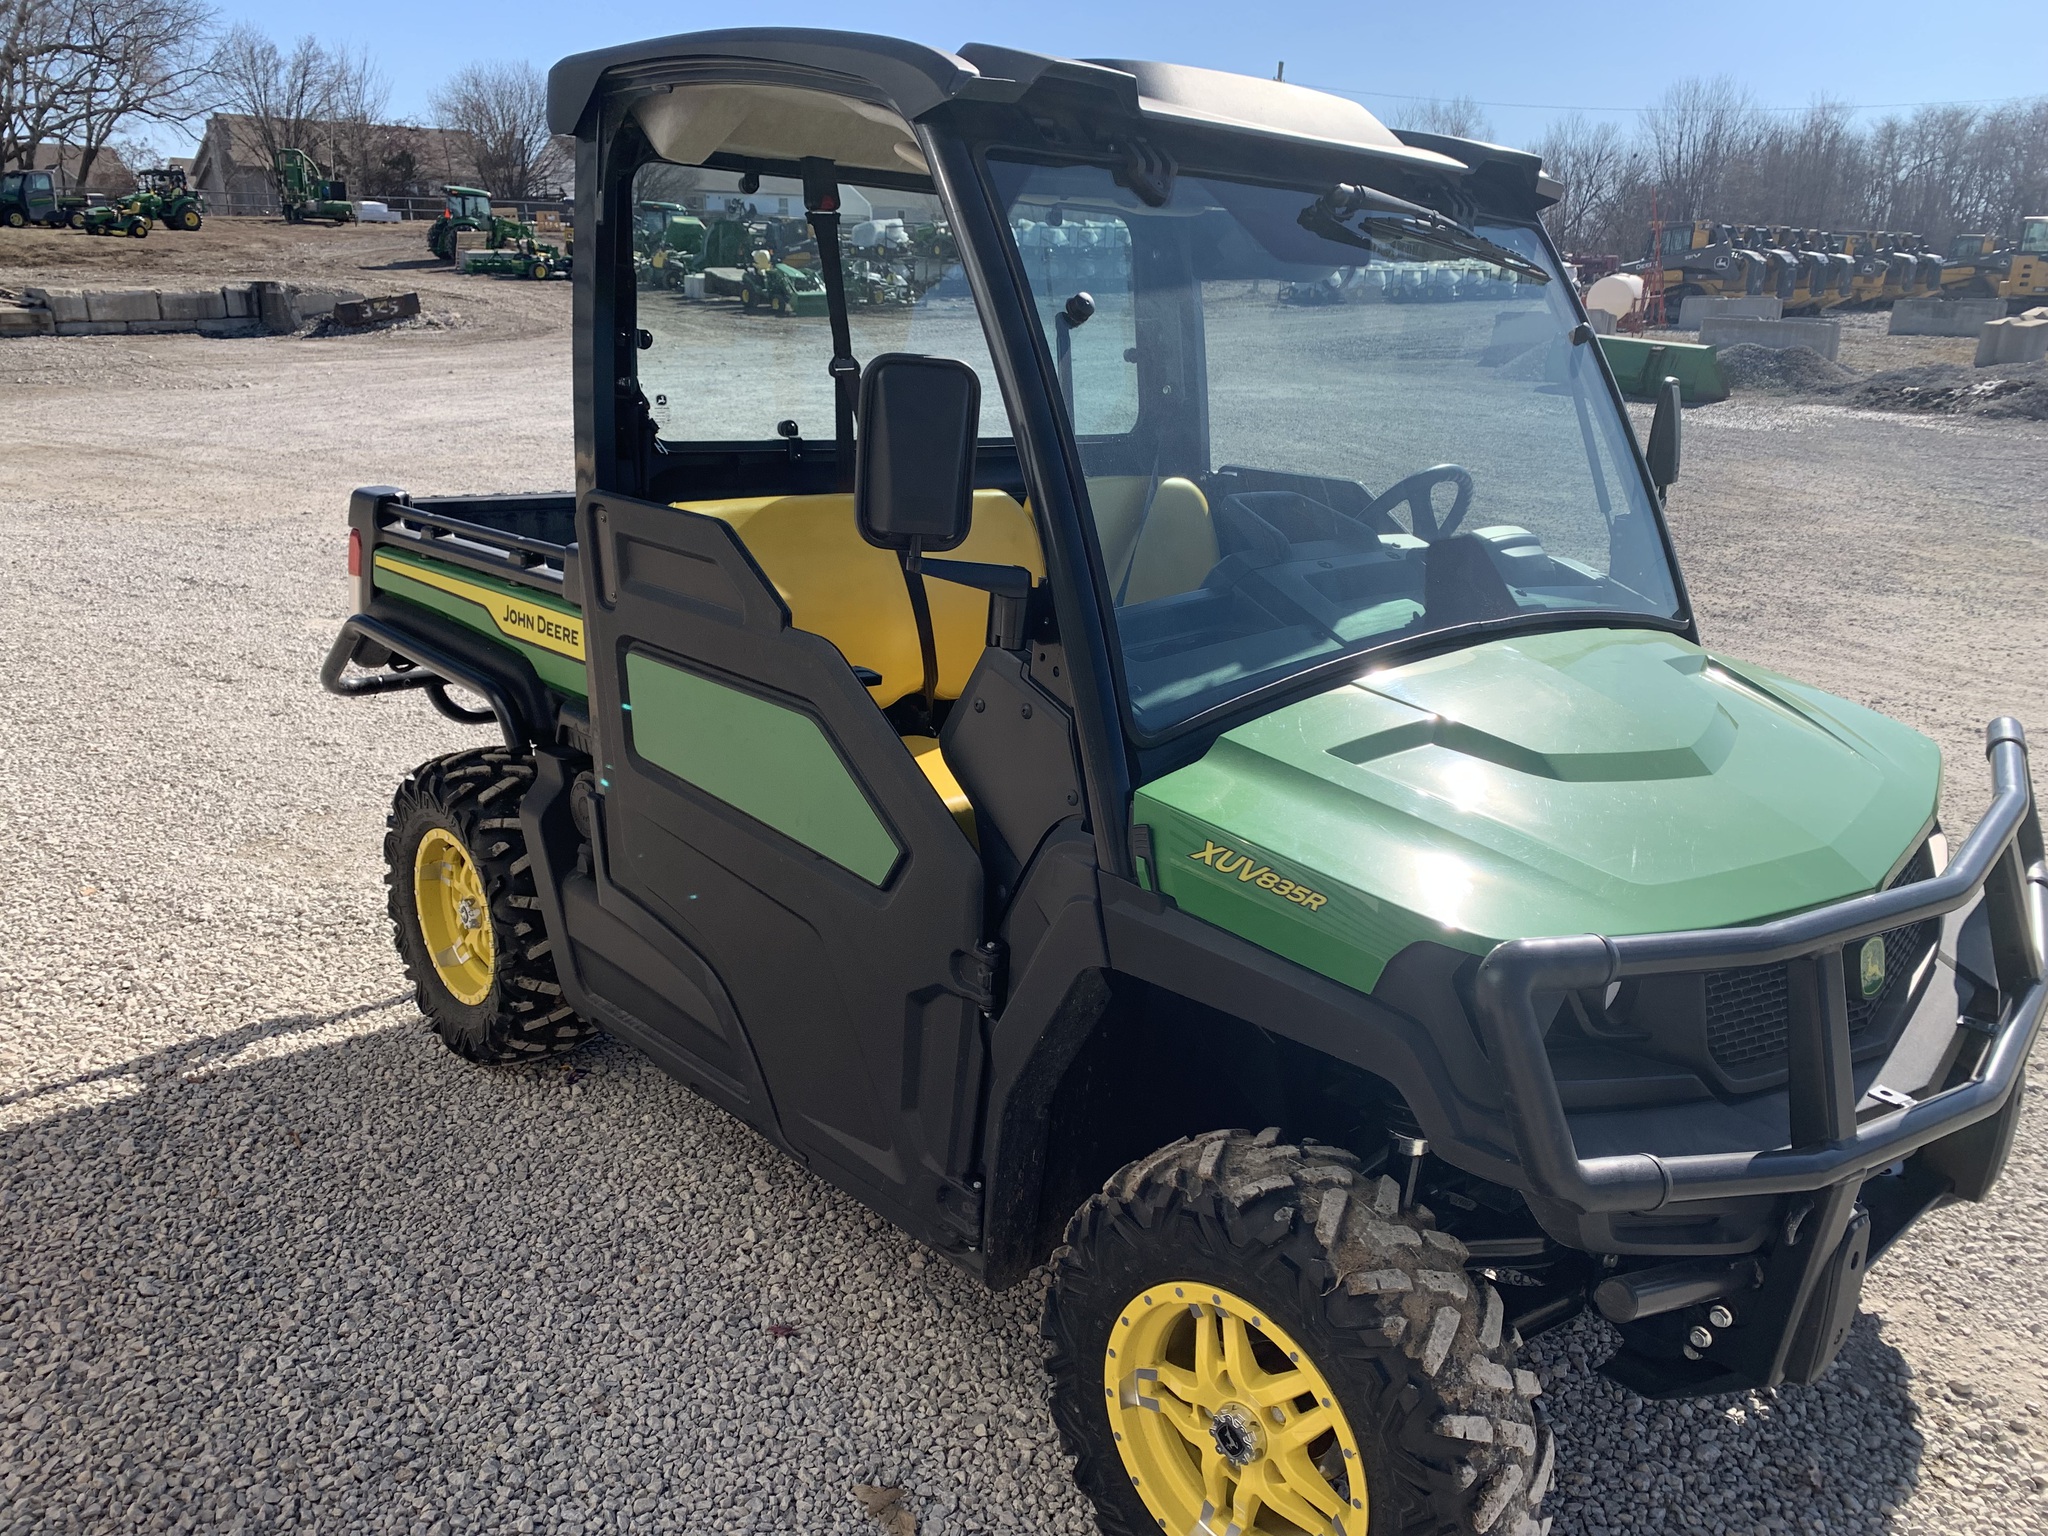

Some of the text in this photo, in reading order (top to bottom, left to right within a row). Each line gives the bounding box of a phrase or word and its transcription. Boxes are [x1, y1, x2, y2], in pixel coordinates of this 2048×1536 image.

[503, 604, 579, 646] JOHN DEERE
[1188, 838, 1328, 912] XUV835R
